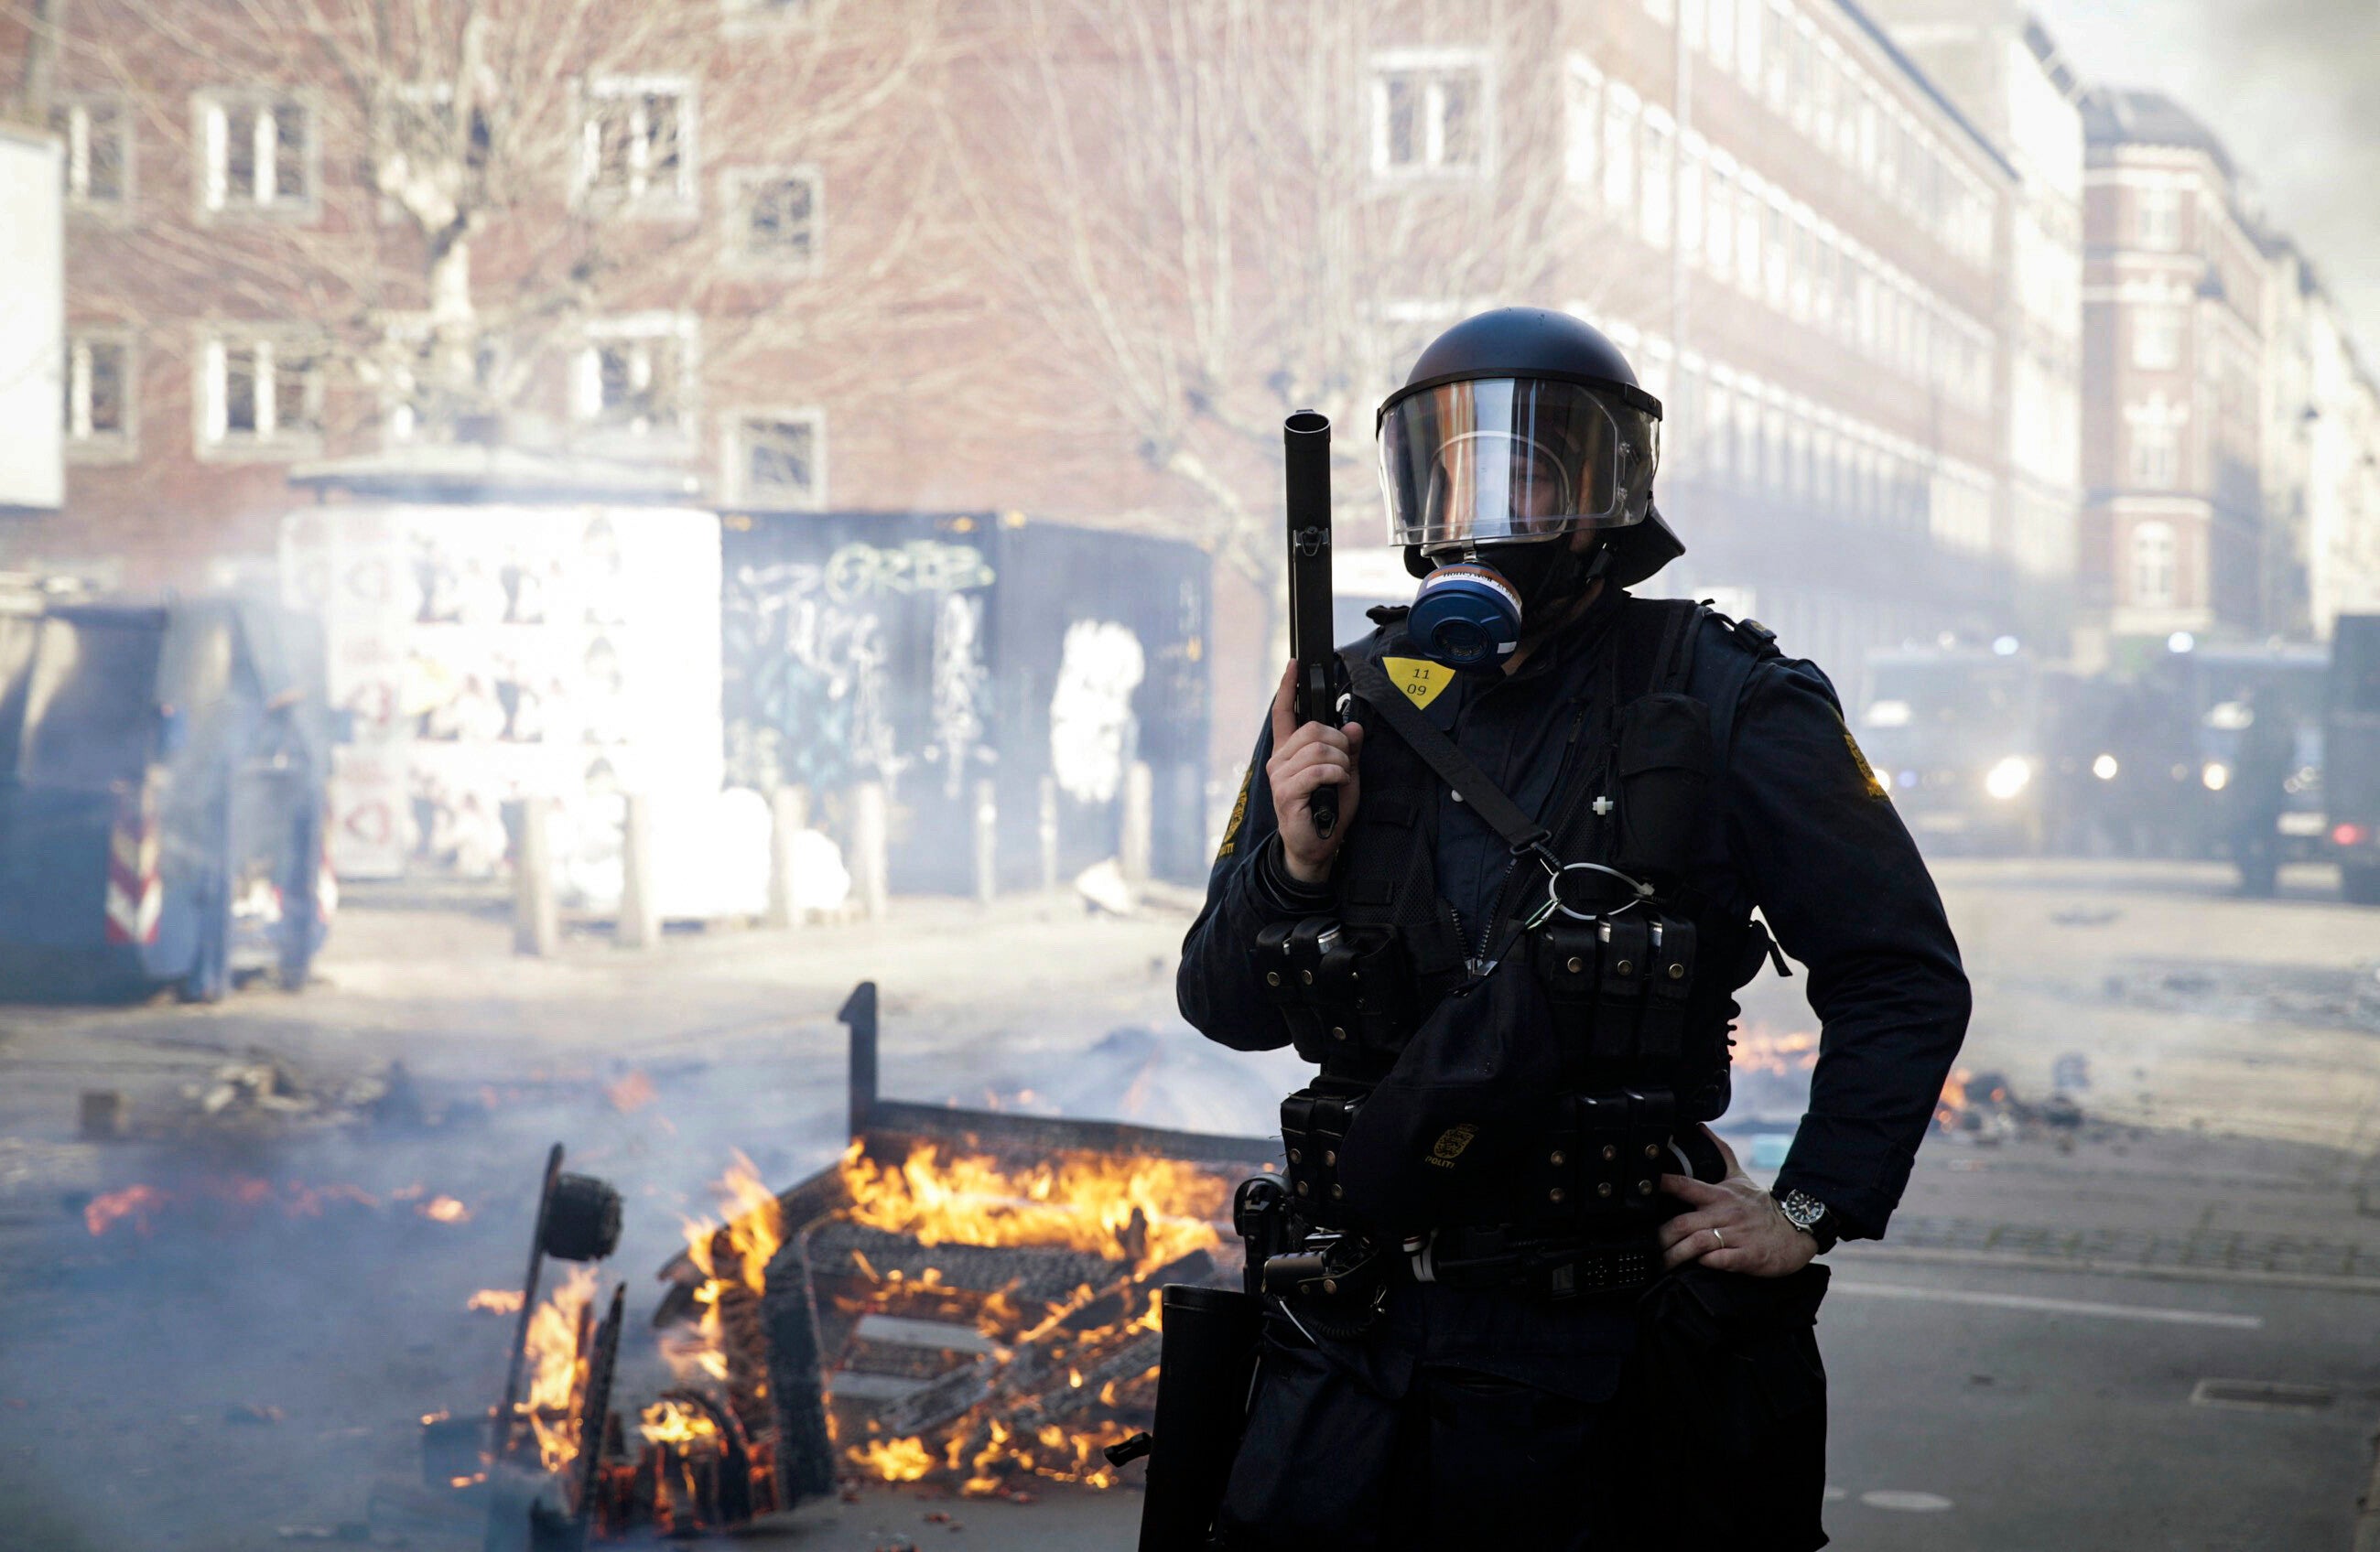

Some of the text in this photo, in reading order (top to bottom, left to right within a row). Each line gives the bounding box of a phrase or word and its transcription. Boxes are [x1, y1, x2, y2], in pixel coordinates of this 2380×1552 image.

[1444, 571, 1493, 583] Honeywell
[1413, 668, 1430, 680] 11
[1407, 684, 1427, 696] 09
[1424, 1155, 1455, 1169] POLITI
